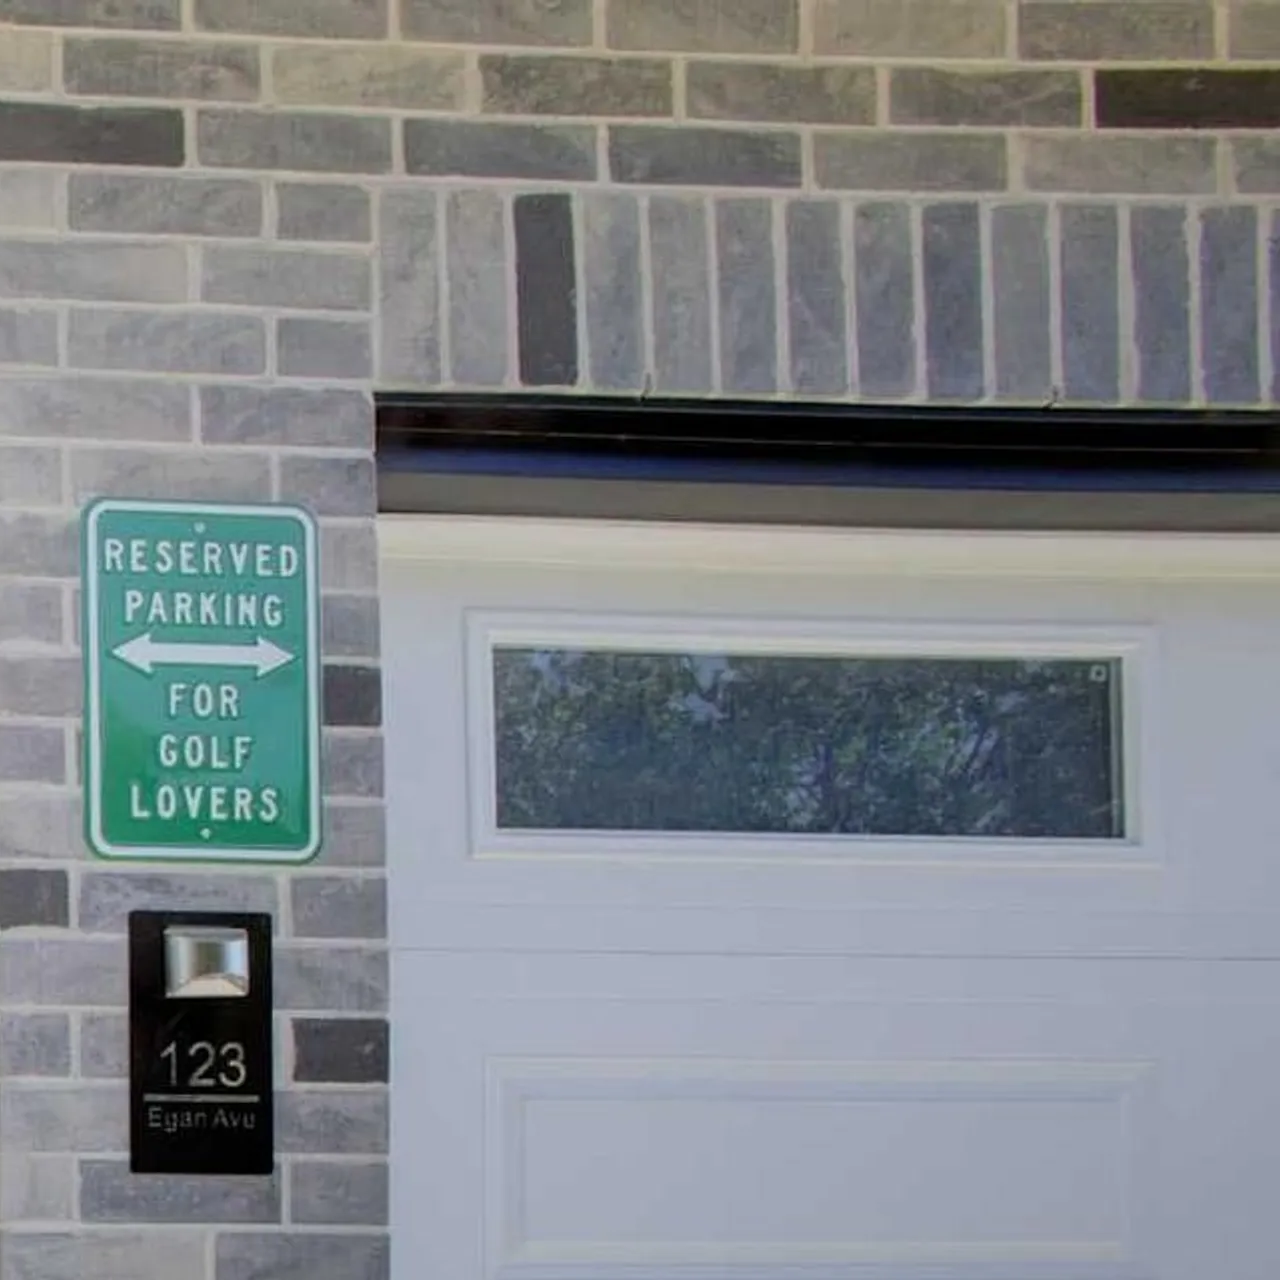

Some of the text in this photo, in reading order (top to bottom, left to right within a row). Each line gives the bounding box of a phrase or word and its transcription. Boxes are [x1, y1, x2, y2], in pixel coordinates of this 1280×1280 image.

[104, 538, 299, 577] RESERVED
[124, 590, 283, 627] PARKING
[169, 683, 239, 718] FOR
[159, 735, 252, 769] GOLF
[129, 784, 278, 823] LOVERS
[160, 1040, 247, 1088] 123
[148, 1106, 208, 1133] Egan
